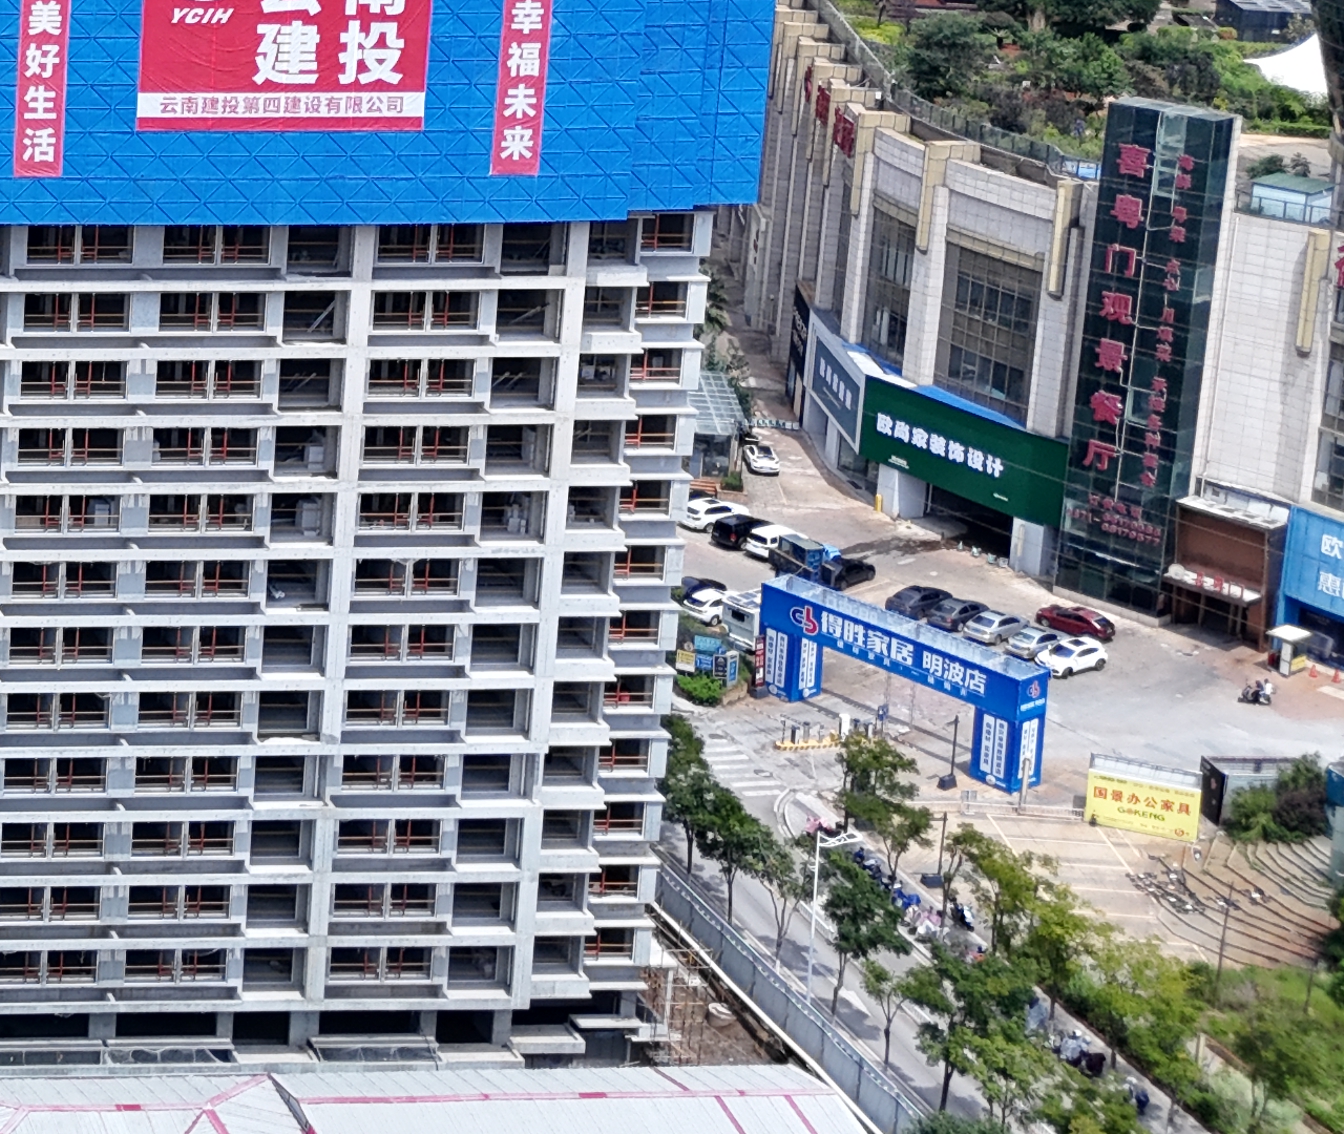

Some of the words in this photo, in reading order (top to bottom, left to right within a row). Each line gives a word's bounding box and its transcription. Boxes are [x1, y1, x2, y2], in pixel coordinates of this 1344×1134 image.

[170, 7, 235, 24] YCIH
[252, 19, 406, 86] 建投
[159, 95, 406, 117] 云南建投第四建设有限公司
[821, 611, 914, 666] 得胜家居
[922, 650, 987, 697] 明波店
[1093, 786, 1191, 816] 国景办公家具
